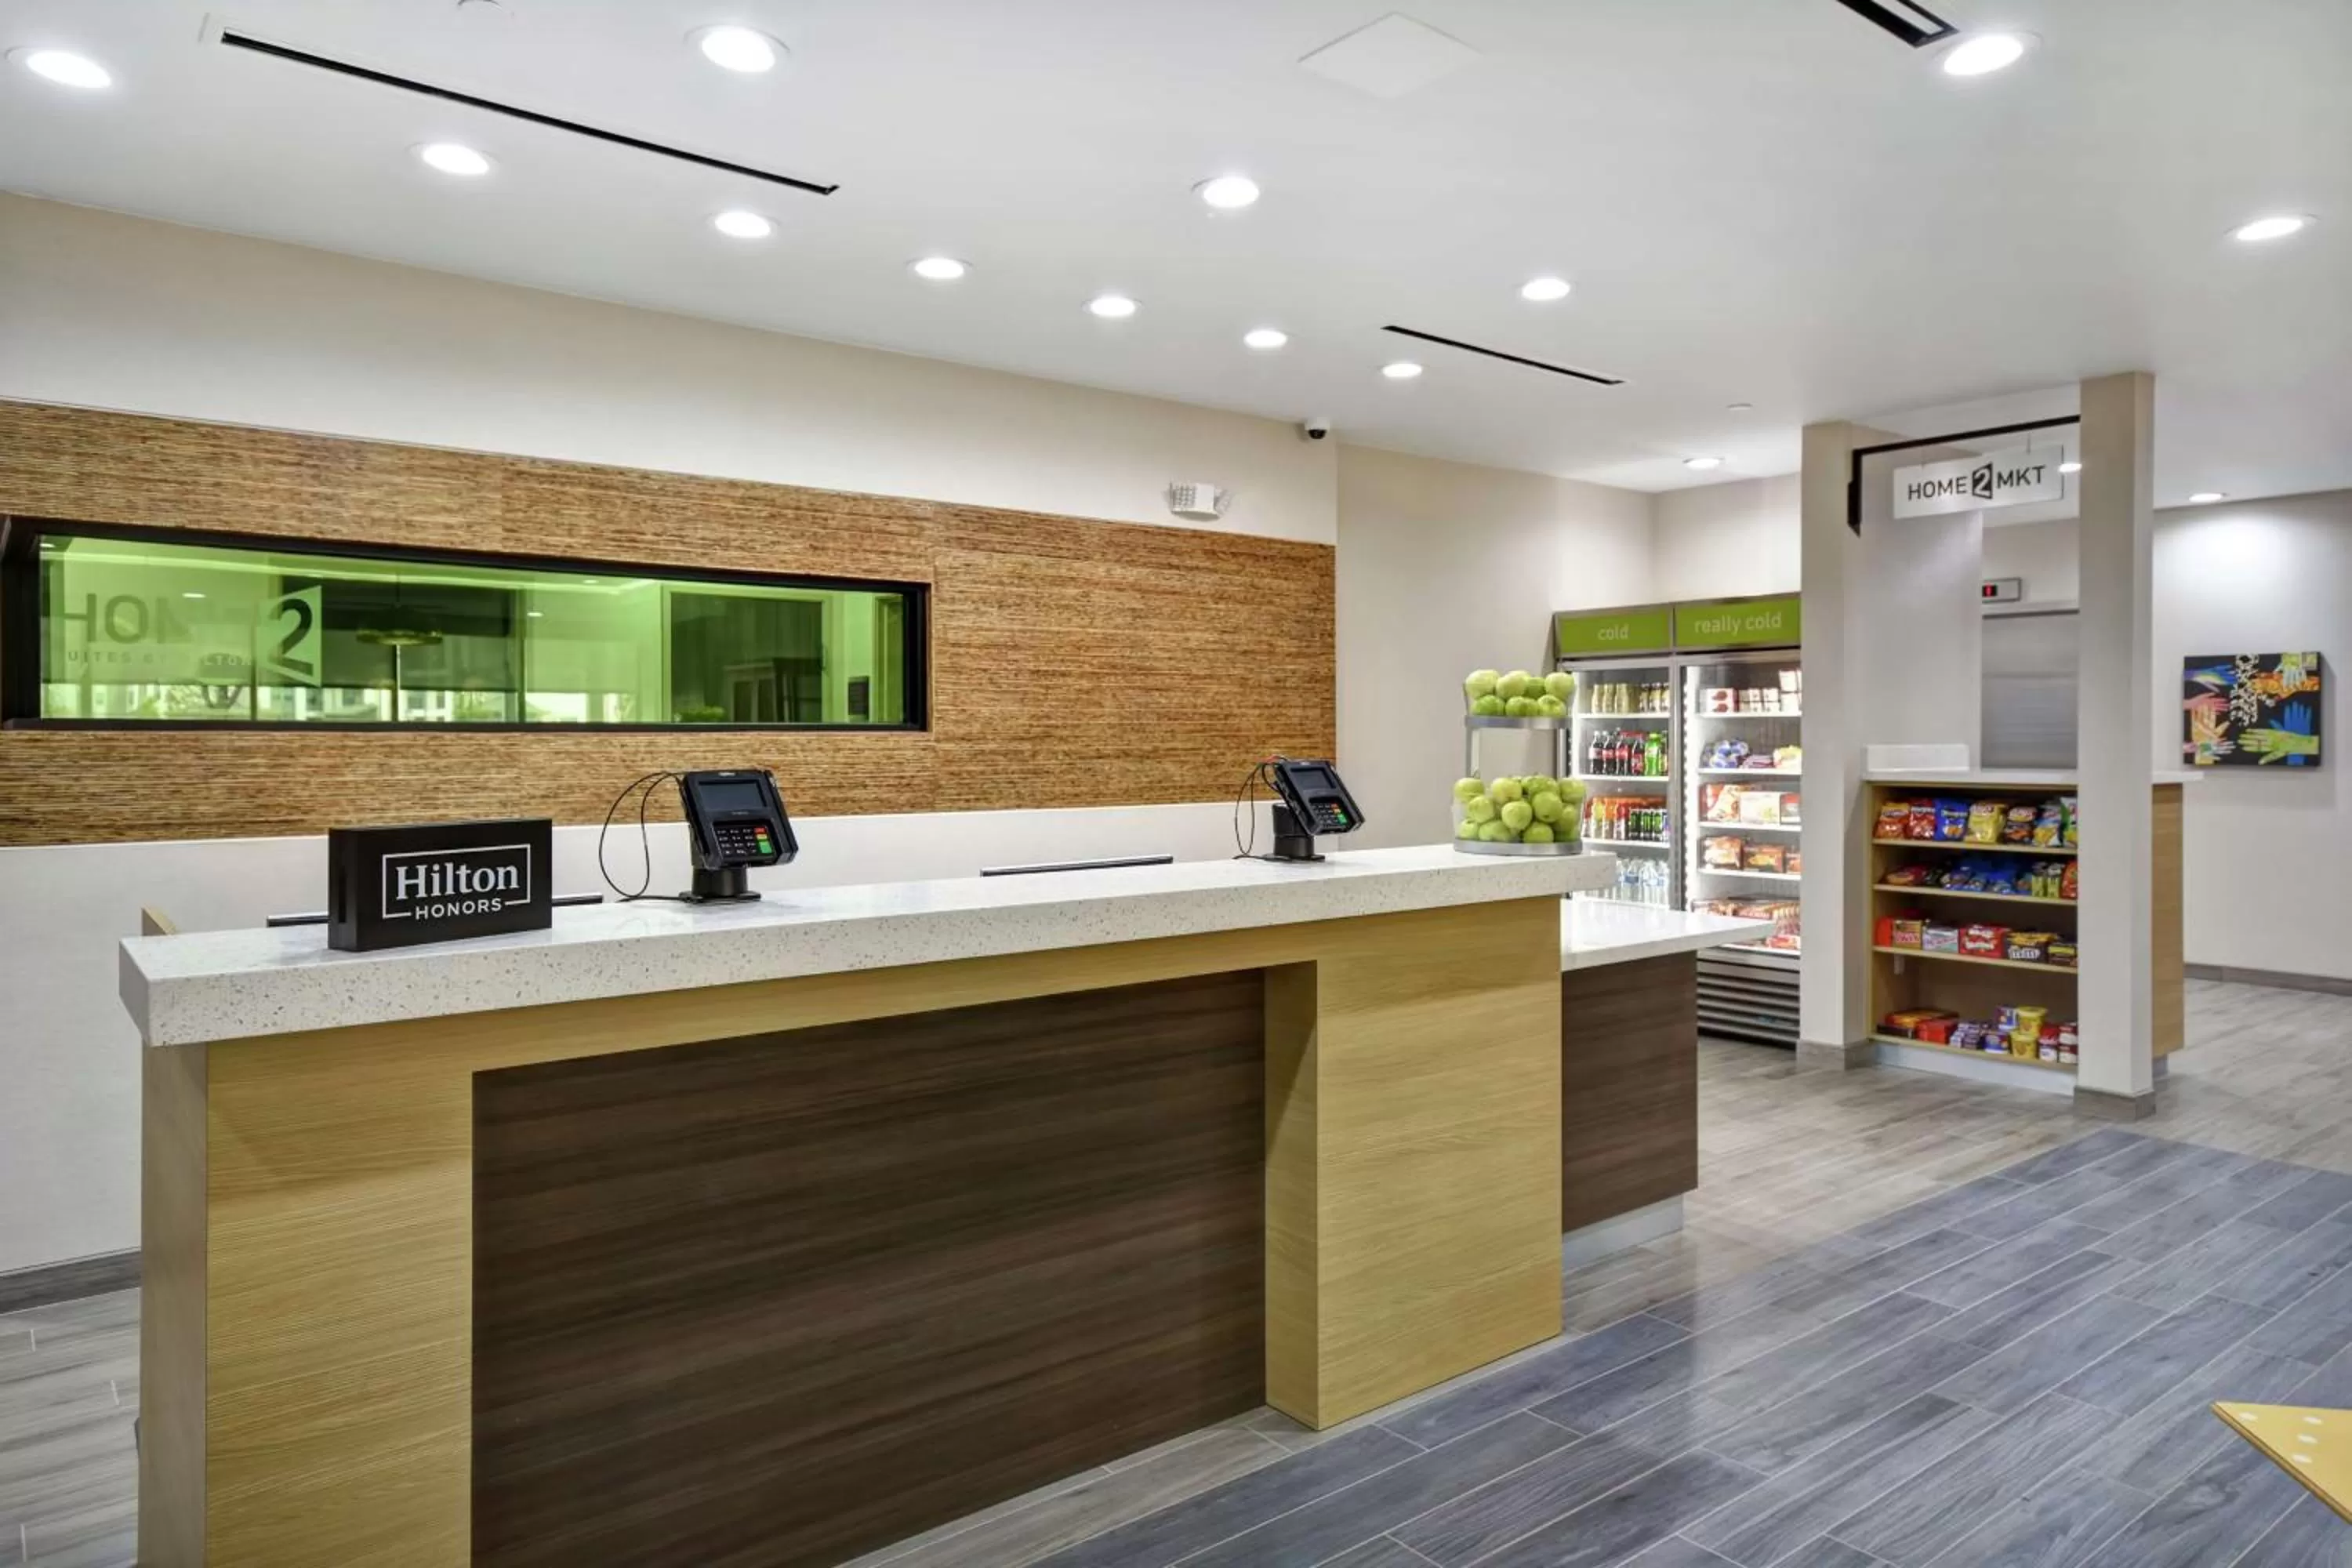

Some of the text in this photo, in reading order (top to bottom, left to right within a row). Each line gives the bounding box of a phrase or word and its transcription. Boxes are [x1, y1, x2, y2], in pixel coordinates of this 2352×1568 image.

[1907, 476, 1969, 500] HOME
[1996, 464, 2045, 489] MKT
[1597, 624, 1629, 641] cold
[1693, 612, 1782, 637] really cold
[395, 862, 520, 900] Hilton
[415, 898, 503, 920] HONORS
